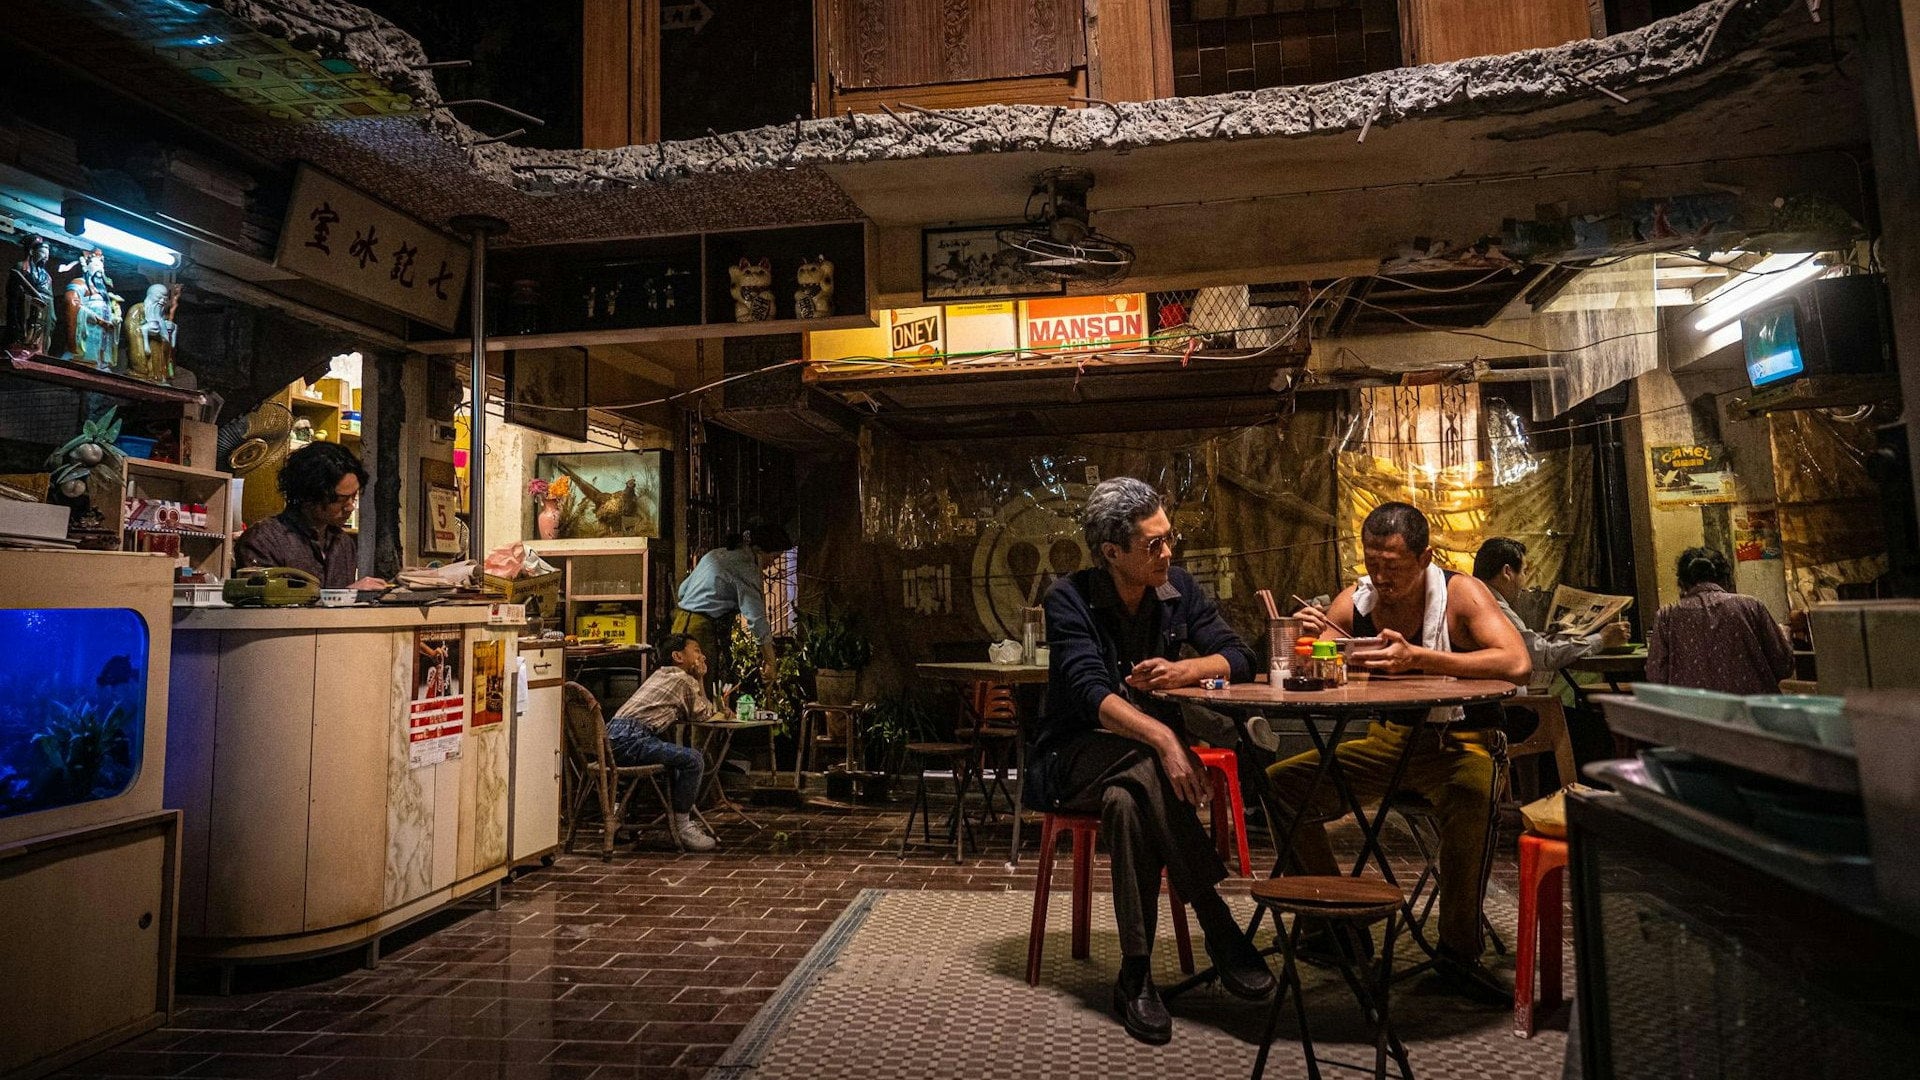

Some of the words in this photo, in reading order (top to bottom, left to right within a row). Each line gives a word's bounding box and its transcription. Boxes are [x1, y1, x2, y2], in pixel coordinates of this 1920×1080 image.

[1029, 314, 1142, 341] MANSON
[1662, 446, 1712, 464] CAMEL
[437, 504, 447, 529] 5
